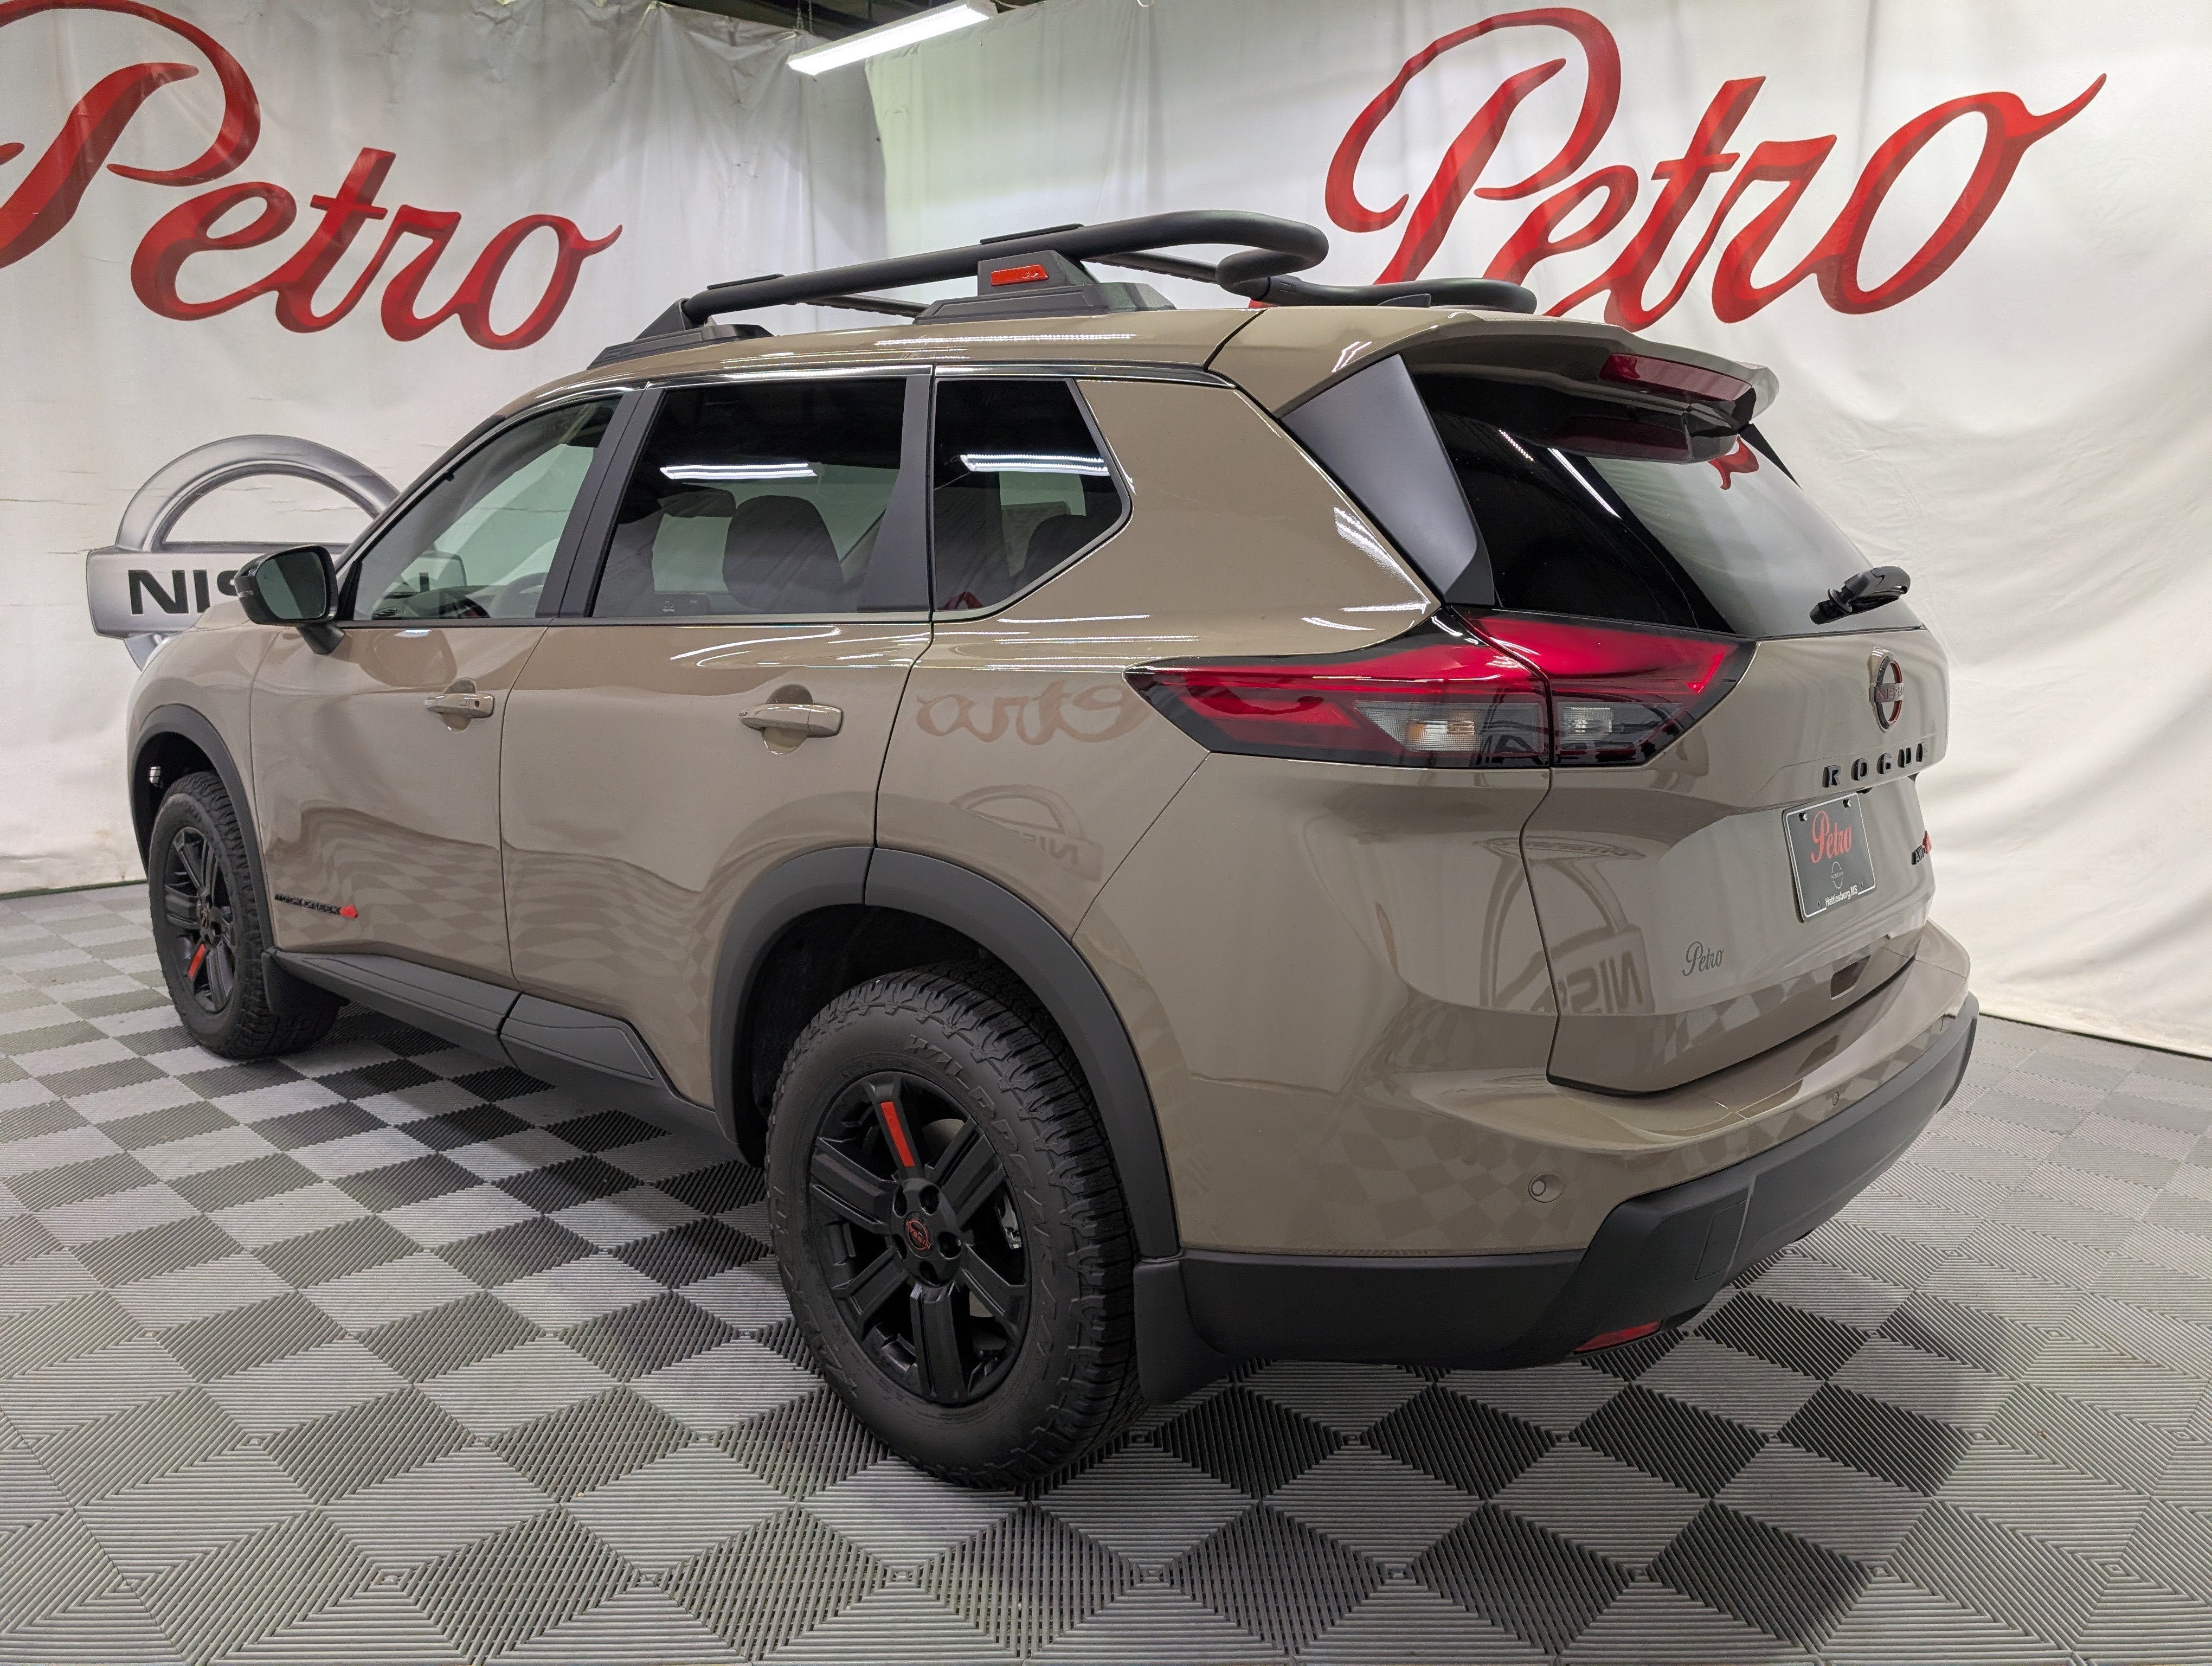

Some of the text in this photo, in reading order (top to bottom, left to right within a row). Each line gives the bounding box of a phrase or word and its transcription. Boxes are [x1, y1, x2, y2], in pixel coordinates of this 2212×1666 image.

[0, 0, 623, 350] Petro
[1325, 7, 2107, 332] Petro
[1822, 741, 1928, 788] ROGUE
[1810, 810, 1853, 863] Petro
[1682, 941, 1725, 977] Petro
